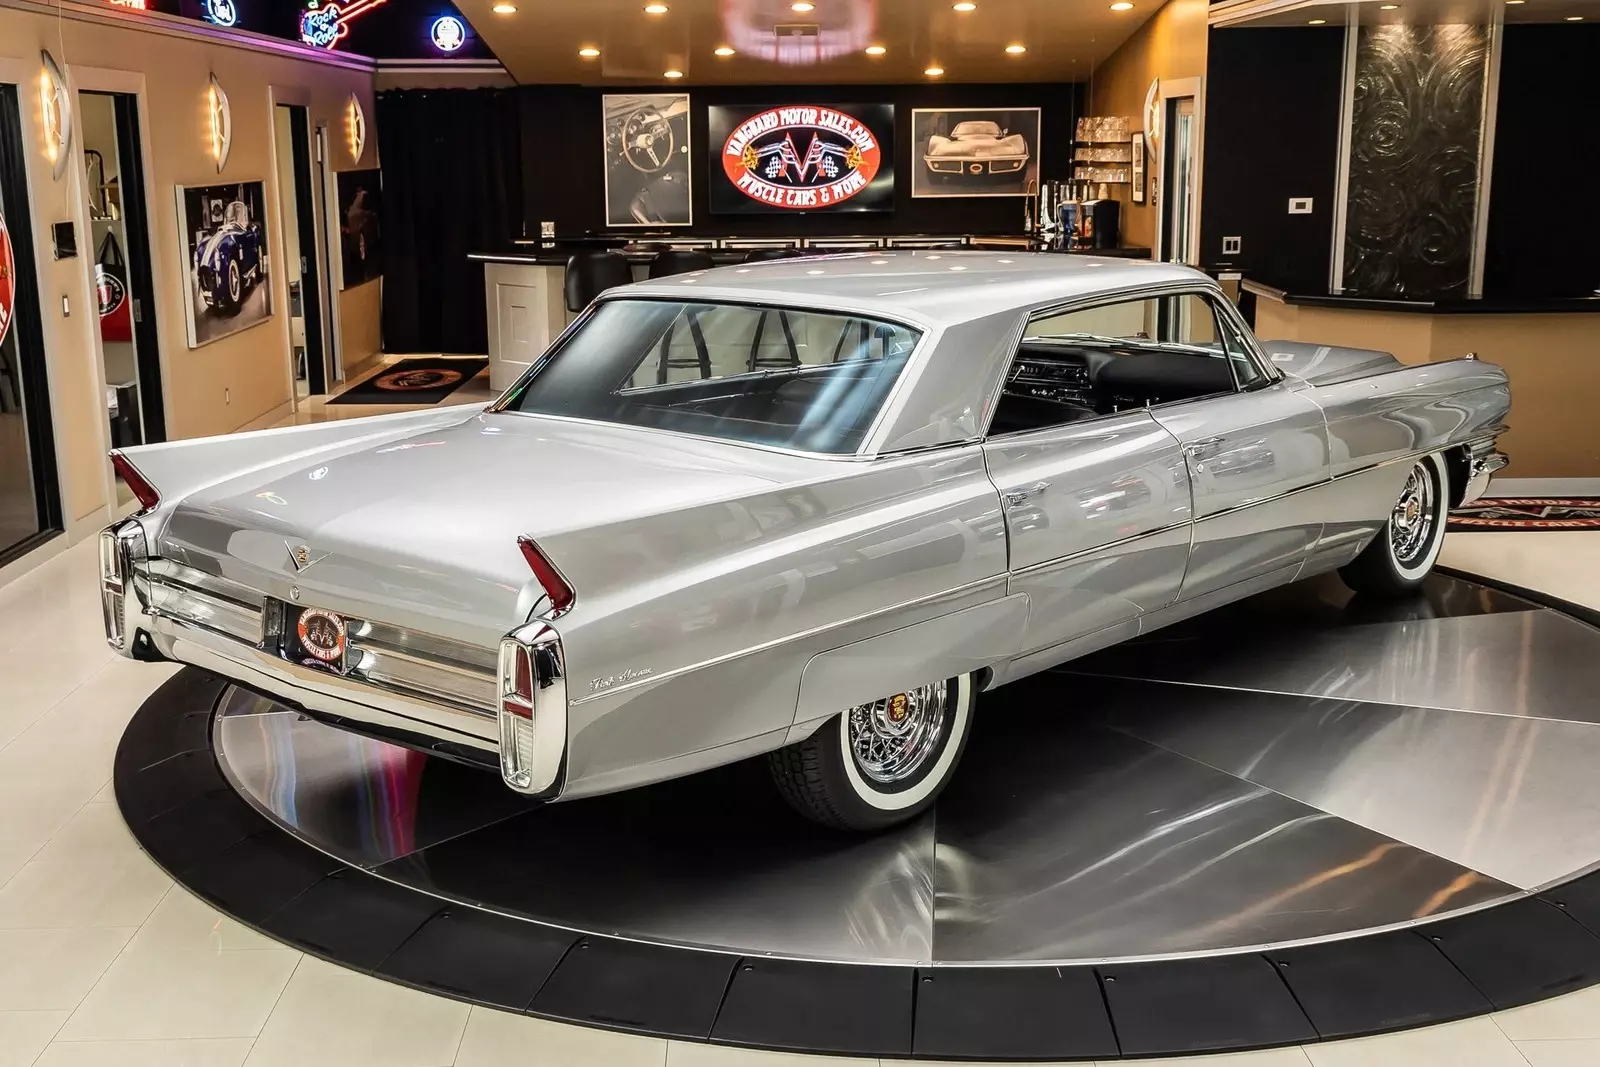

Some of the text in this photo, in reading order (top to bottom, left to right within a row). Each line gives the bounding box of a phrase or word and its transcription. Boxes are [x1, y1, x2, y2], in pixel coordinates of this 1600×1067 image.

[308, 6, 338, 27] Rock
[313, 22, 339, 46] Roll
[726, 108, 876, 156] VANGUARD MOTOR SALES.COM
[736, 169, 867, 206] MUSCLE CARS & MORE
